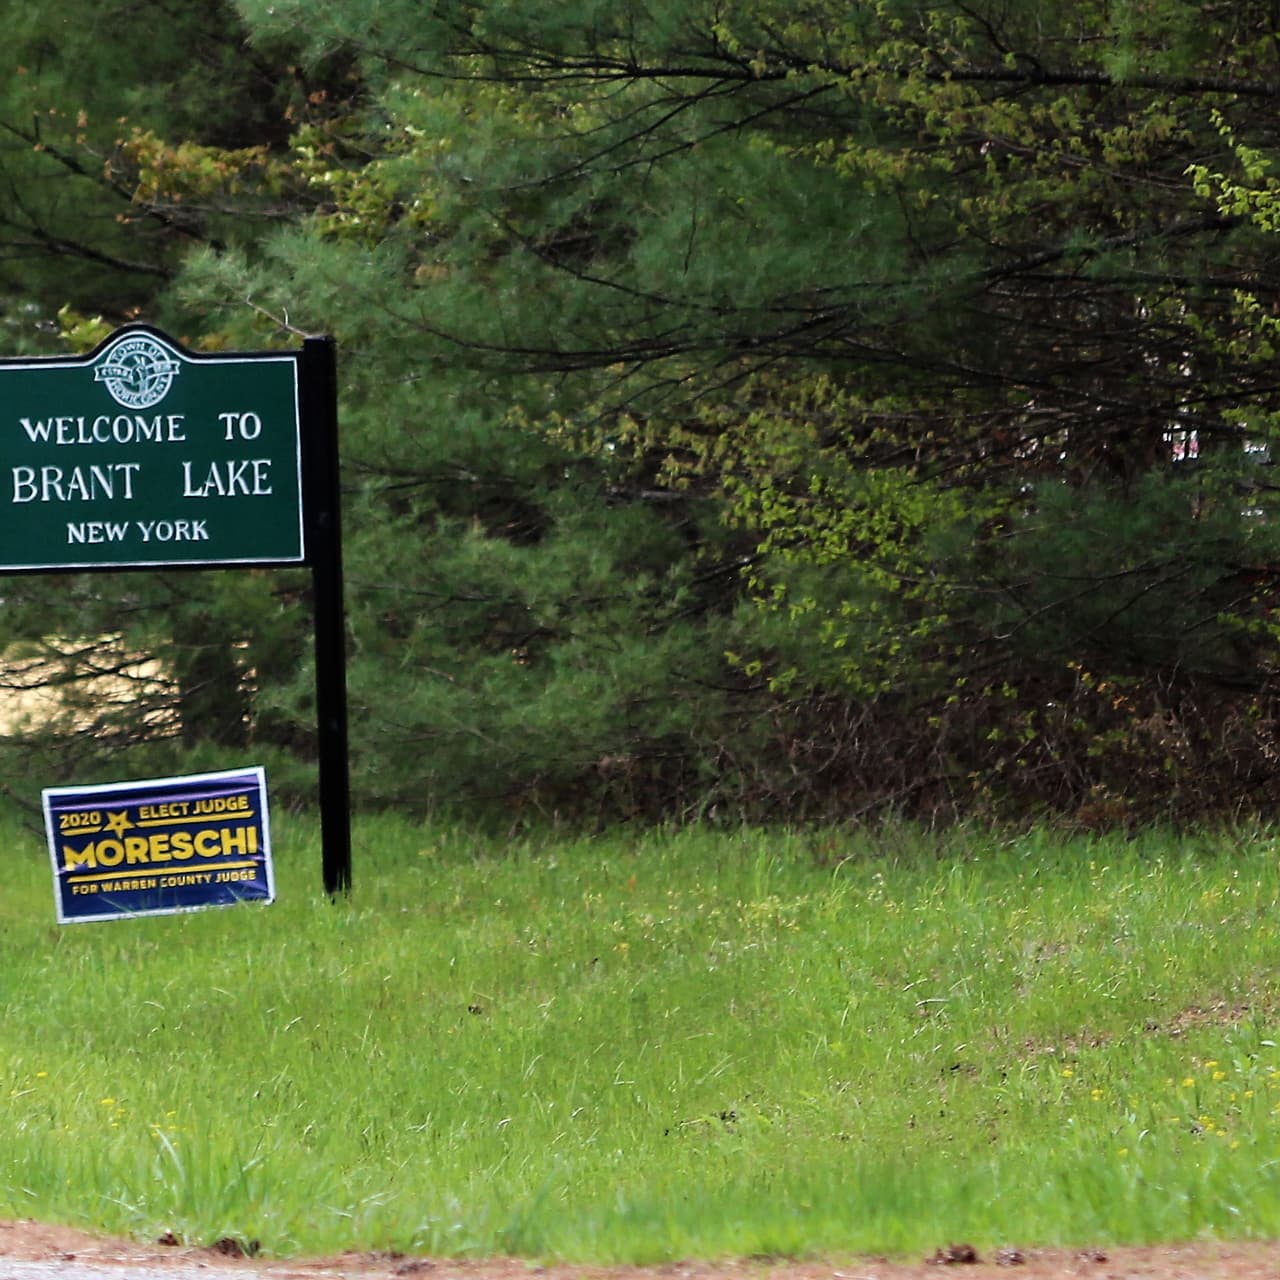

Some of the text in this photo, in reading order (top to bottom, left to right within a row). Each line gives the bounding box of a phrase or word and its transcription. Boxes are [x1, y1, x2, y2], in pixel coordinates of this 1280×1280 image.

[20, 412, 261, 445] WELCOME TO
[11, 459, 273, 503] BRANT LAKE
[66, 520, 209, 544] NEW YORK
[59, 795, 249, 829] 2020 ELECT JUDGE
[62, 826, 258, 871] MORESCHI
[72, 870, 257, 896] FOR WARREN COUNTY JUDGE
